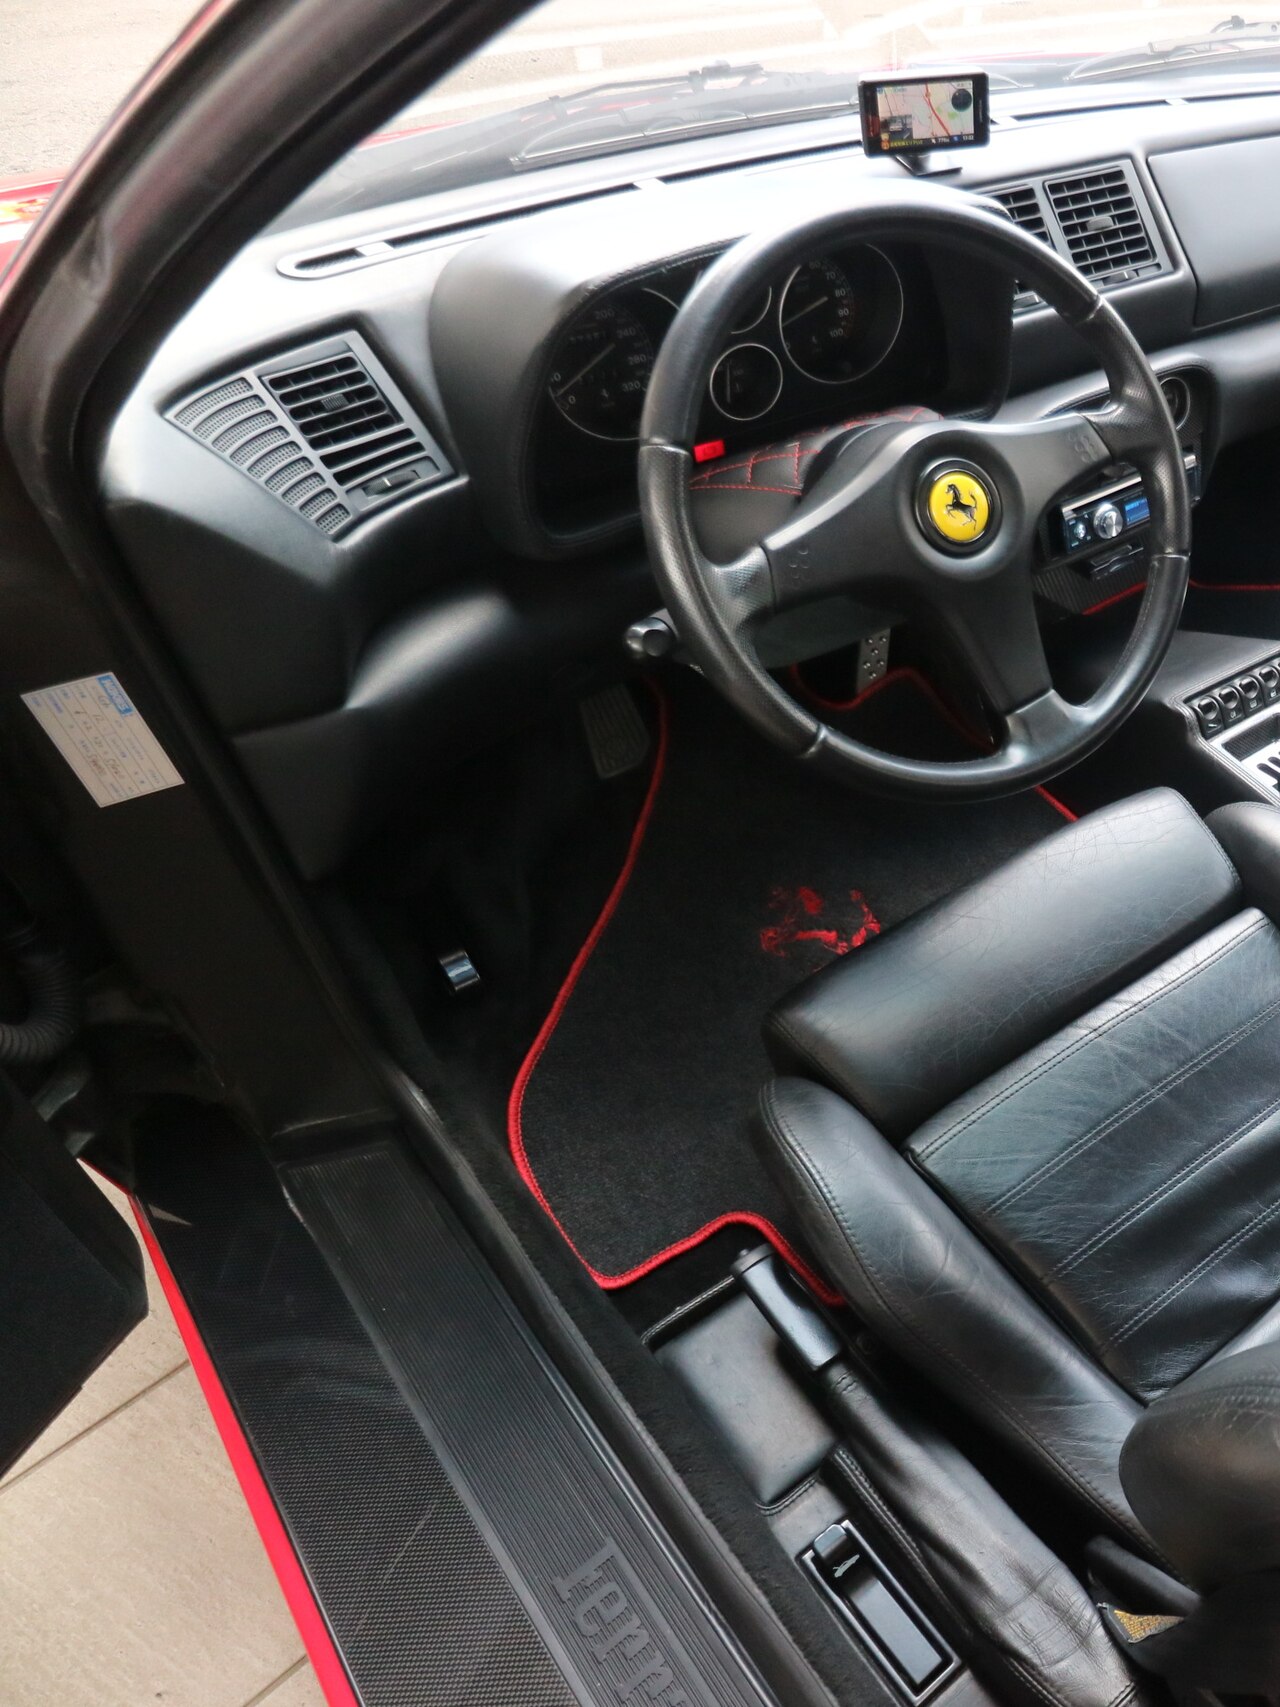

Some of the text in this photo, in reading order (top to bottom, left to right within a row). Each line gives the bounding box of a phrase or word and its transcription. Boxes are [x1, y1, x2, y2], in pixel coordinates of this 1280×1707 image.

[825, 271, 836, 281] 70
[834, 288, 846, 297] 80
[838, 308, 850, 317] 90
[829, 328, 844, 338] 100
[551, 1535, 716, 1707] Ferr
